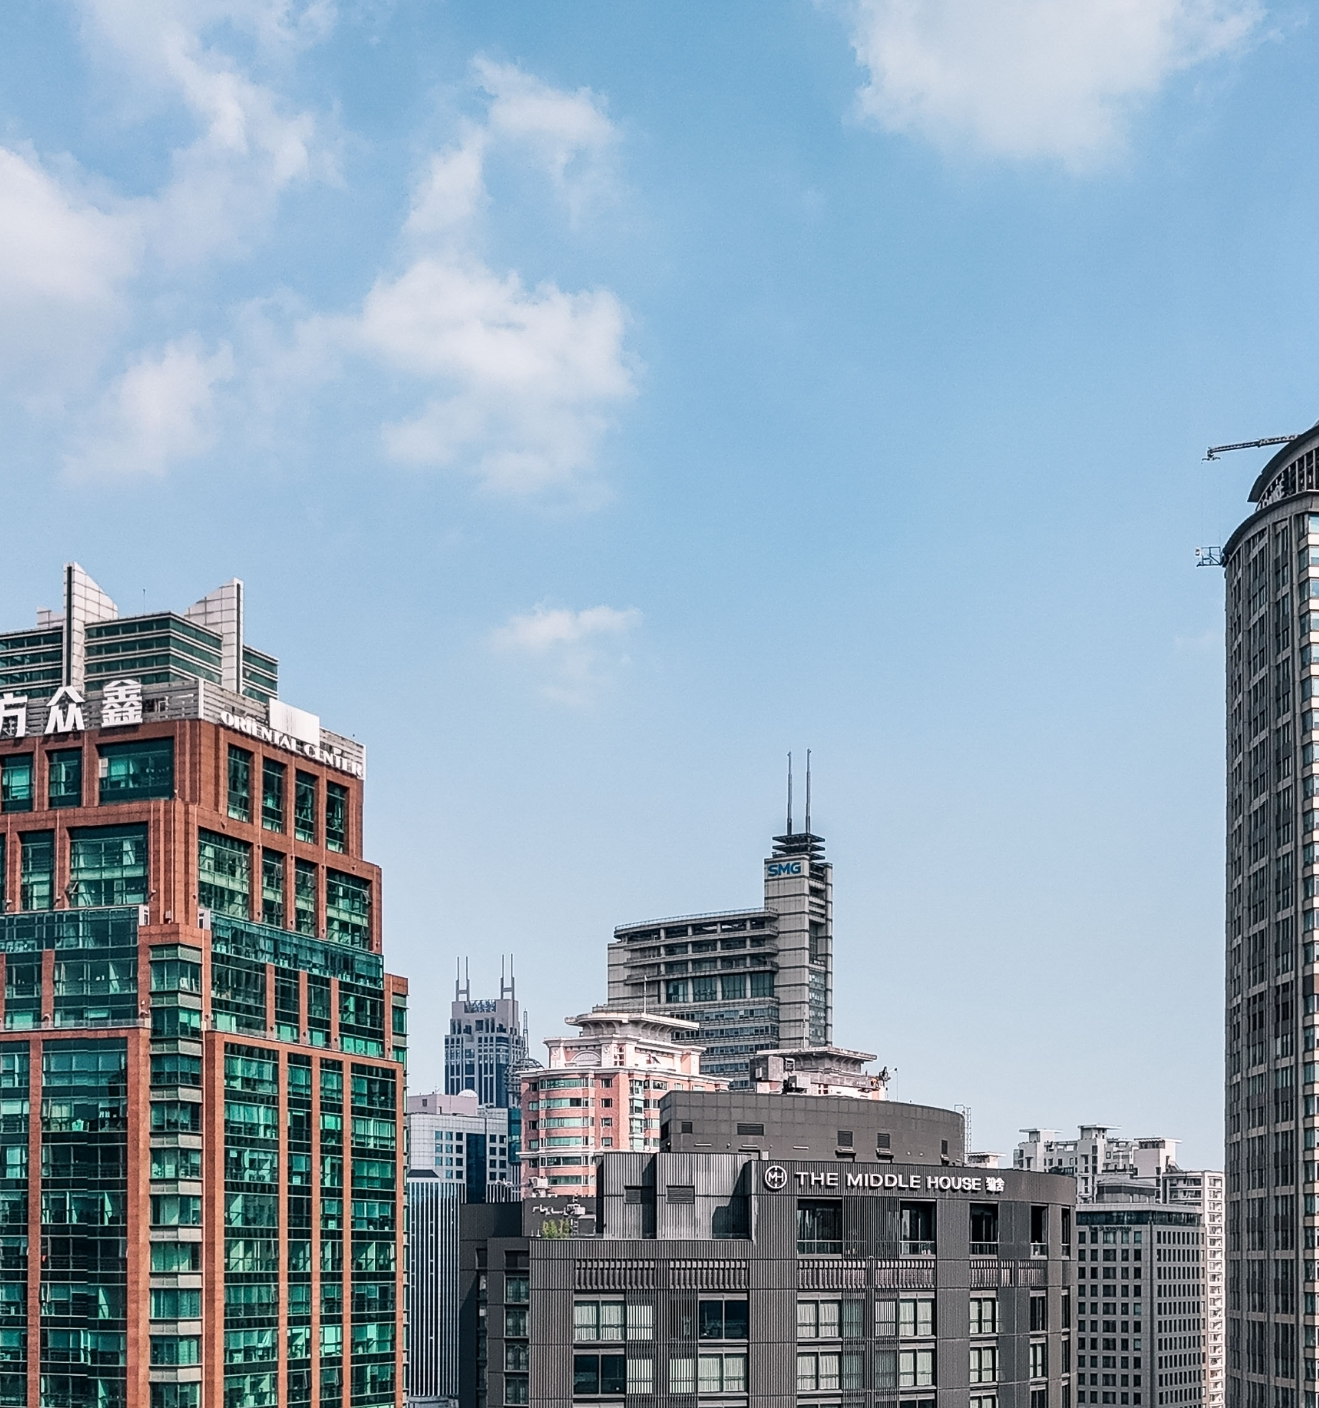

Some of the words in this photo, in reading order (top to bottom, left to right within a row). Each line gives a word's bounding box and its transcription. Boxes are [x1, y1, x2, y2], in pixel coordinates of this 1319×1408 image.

[220, 711, 304, 754] ORIENTAL
[303, 743, 364, 777] CENTER
[768, 862, 801, 876] SMG
[796, 1171, 838, 1186] THE
[847, 1173, 921, 1188] MIDDLE
[927, 1176, 981, 1190] HOUSE
